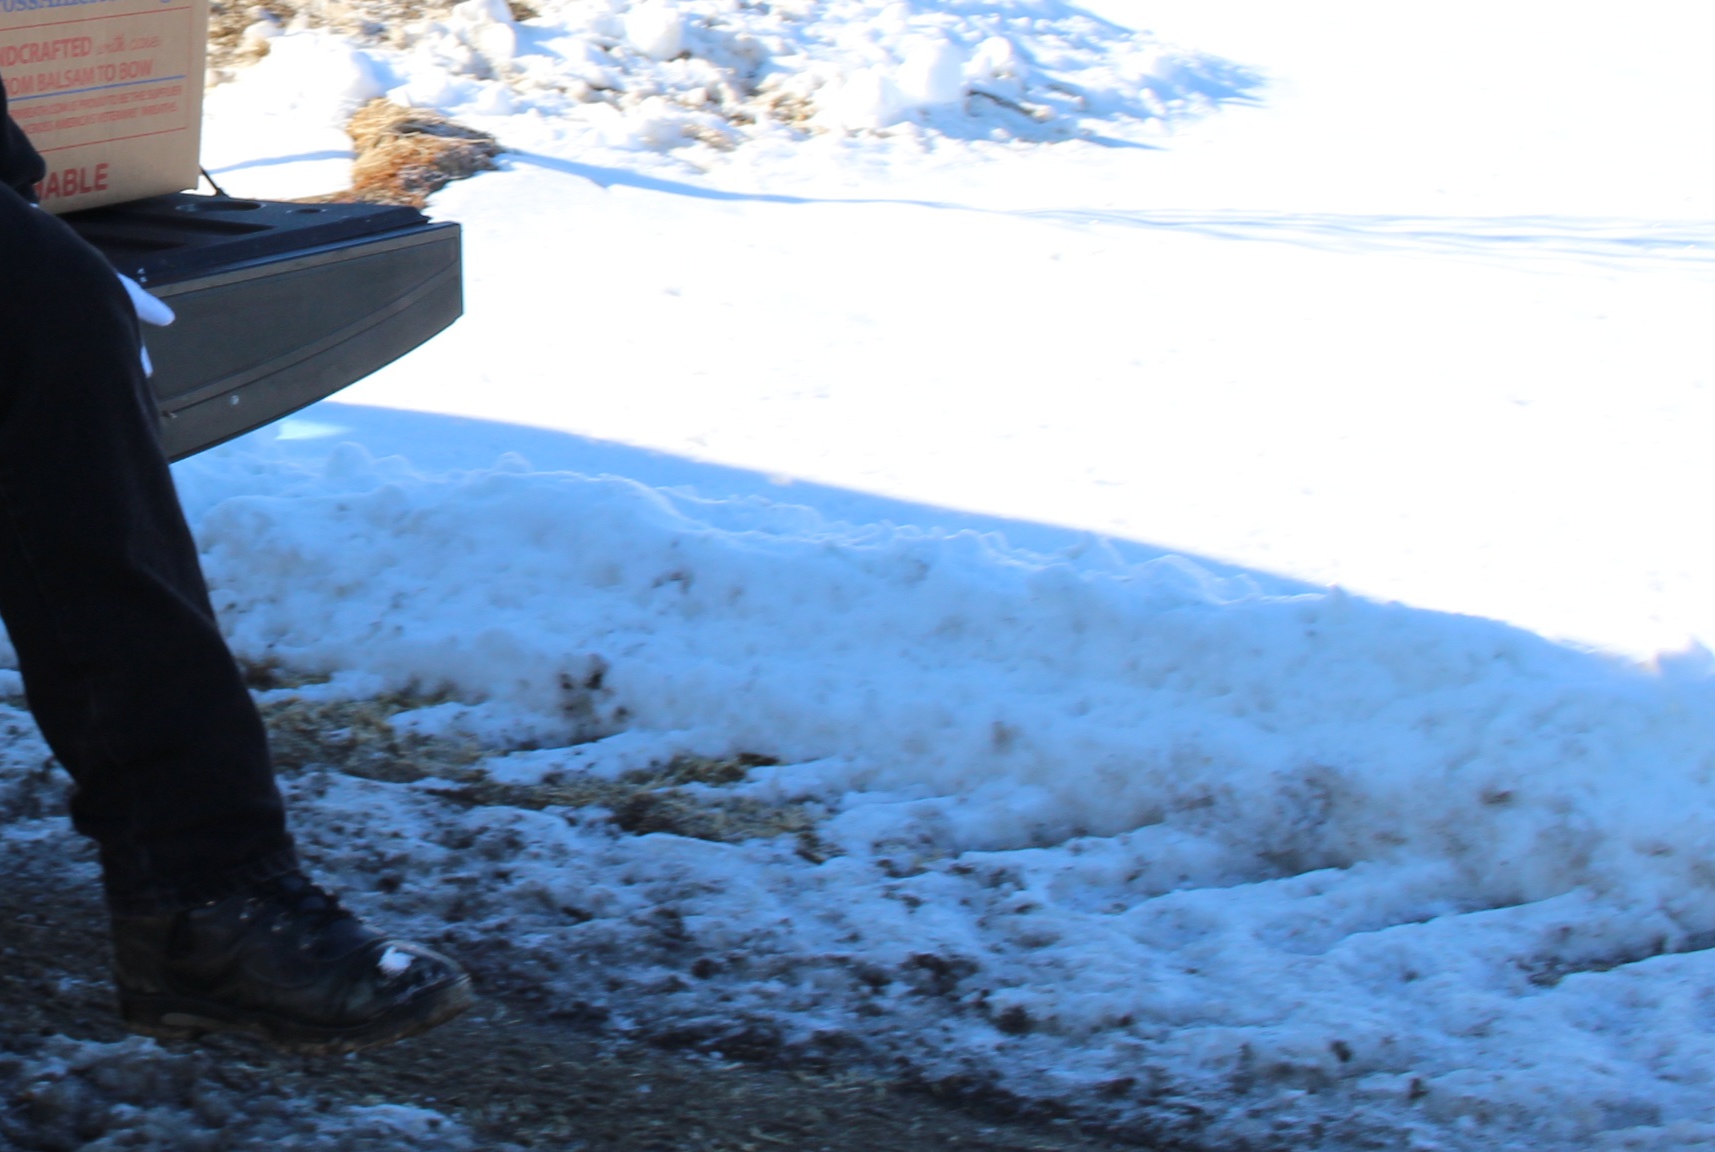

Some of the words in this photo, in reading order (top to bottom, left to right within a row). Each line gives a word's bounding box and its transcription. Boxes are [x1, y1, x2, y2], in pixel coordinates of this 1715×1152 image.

[36, 66, 94, 91] BALSAM
[96, 63, 116, 82] TO
[119, 59, 154, 80] BOW
